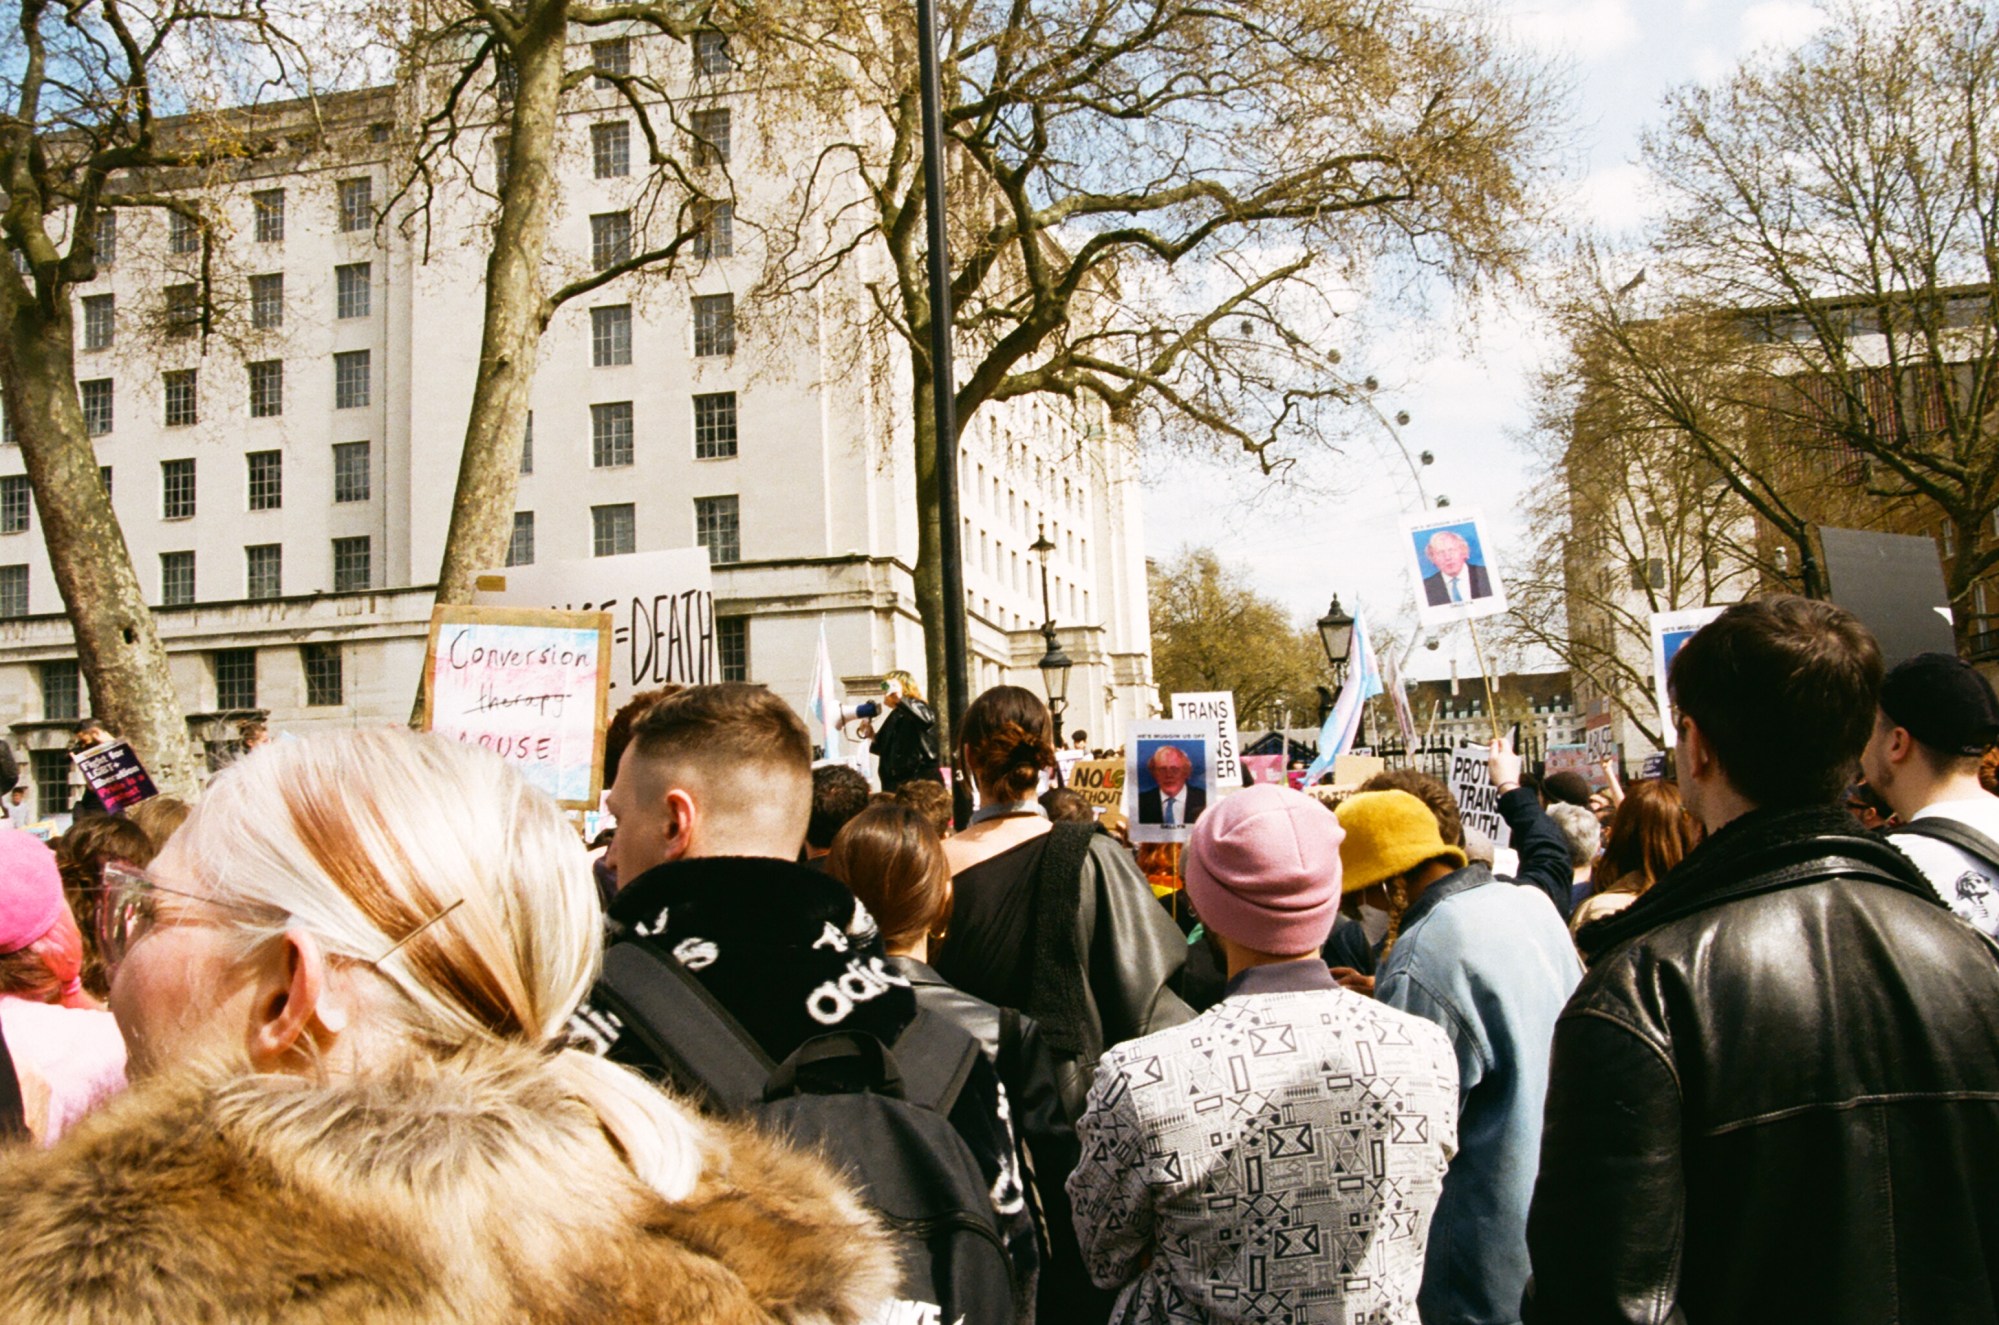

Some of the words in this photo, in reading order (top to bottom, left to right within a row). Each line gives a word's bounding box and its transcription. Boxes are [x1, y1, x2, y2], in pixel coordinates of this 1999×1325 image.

[450, 629, 590, 670] Conversion
[477, 683, 565, 718] therapy
[1178, 700, 1228, 720] TRANS
[1102, 768, 1125, 789] LG
[1453, 756, 1488, 785] PROT
[1075, 788, 1122, 805] THOUT
